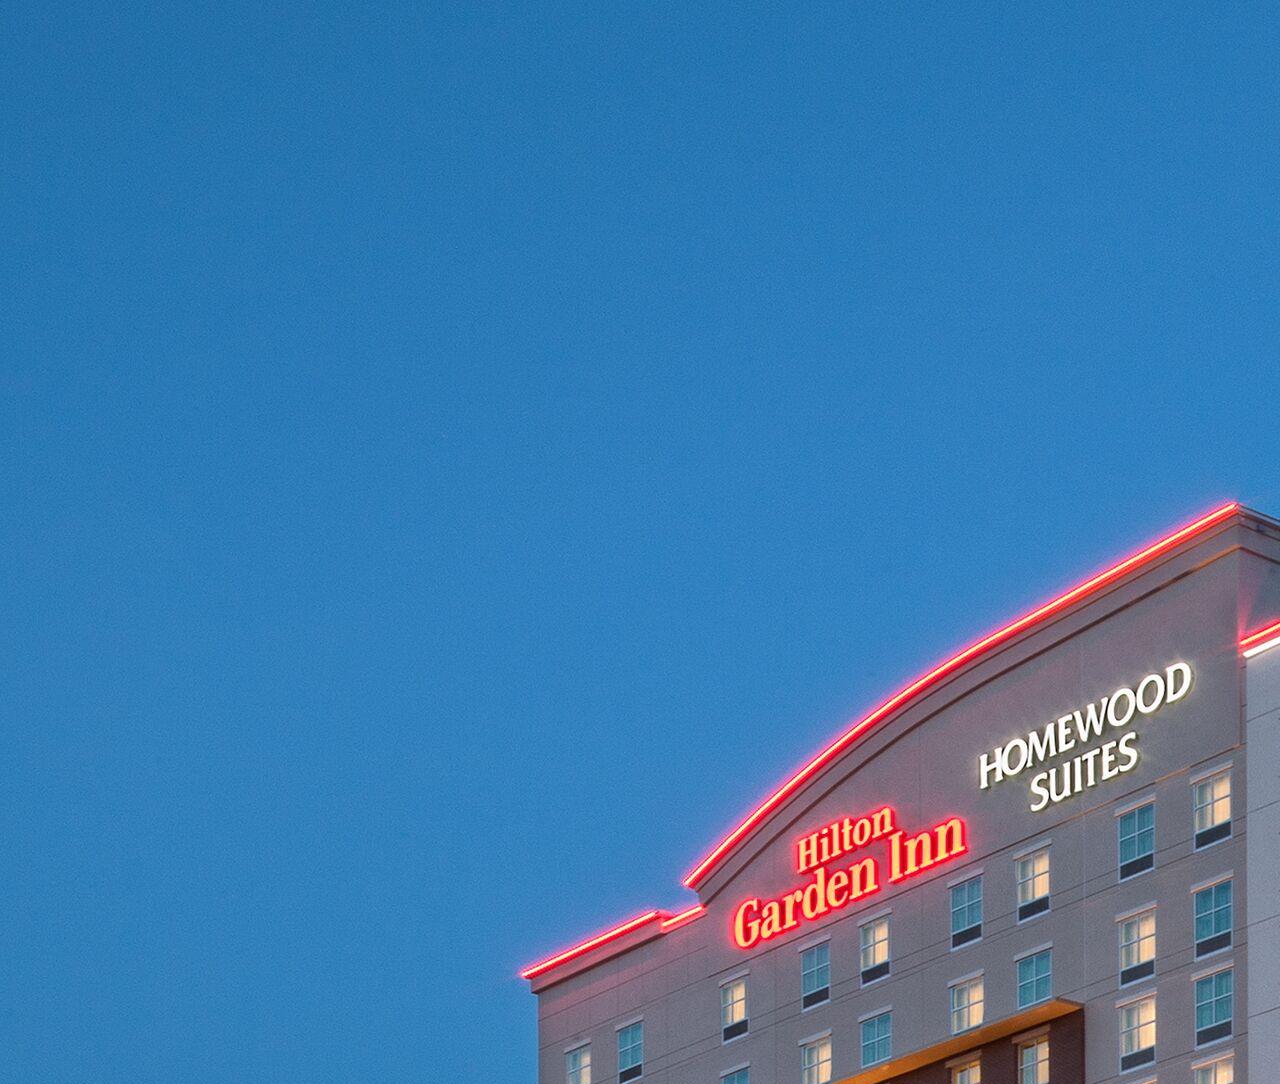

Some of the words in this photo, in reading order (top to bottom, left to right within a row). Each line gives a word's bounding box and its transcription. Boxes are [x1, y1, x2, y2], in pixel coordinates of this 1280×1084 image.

[978, 661, 1193, 789] HOMEWOOD
[1029, 732, 1139, 812] SUITES
[732, 856, 880, 949] Garden
[887, 817, 967, 885] Inn
[796, 805, 896, 874] Hilton
